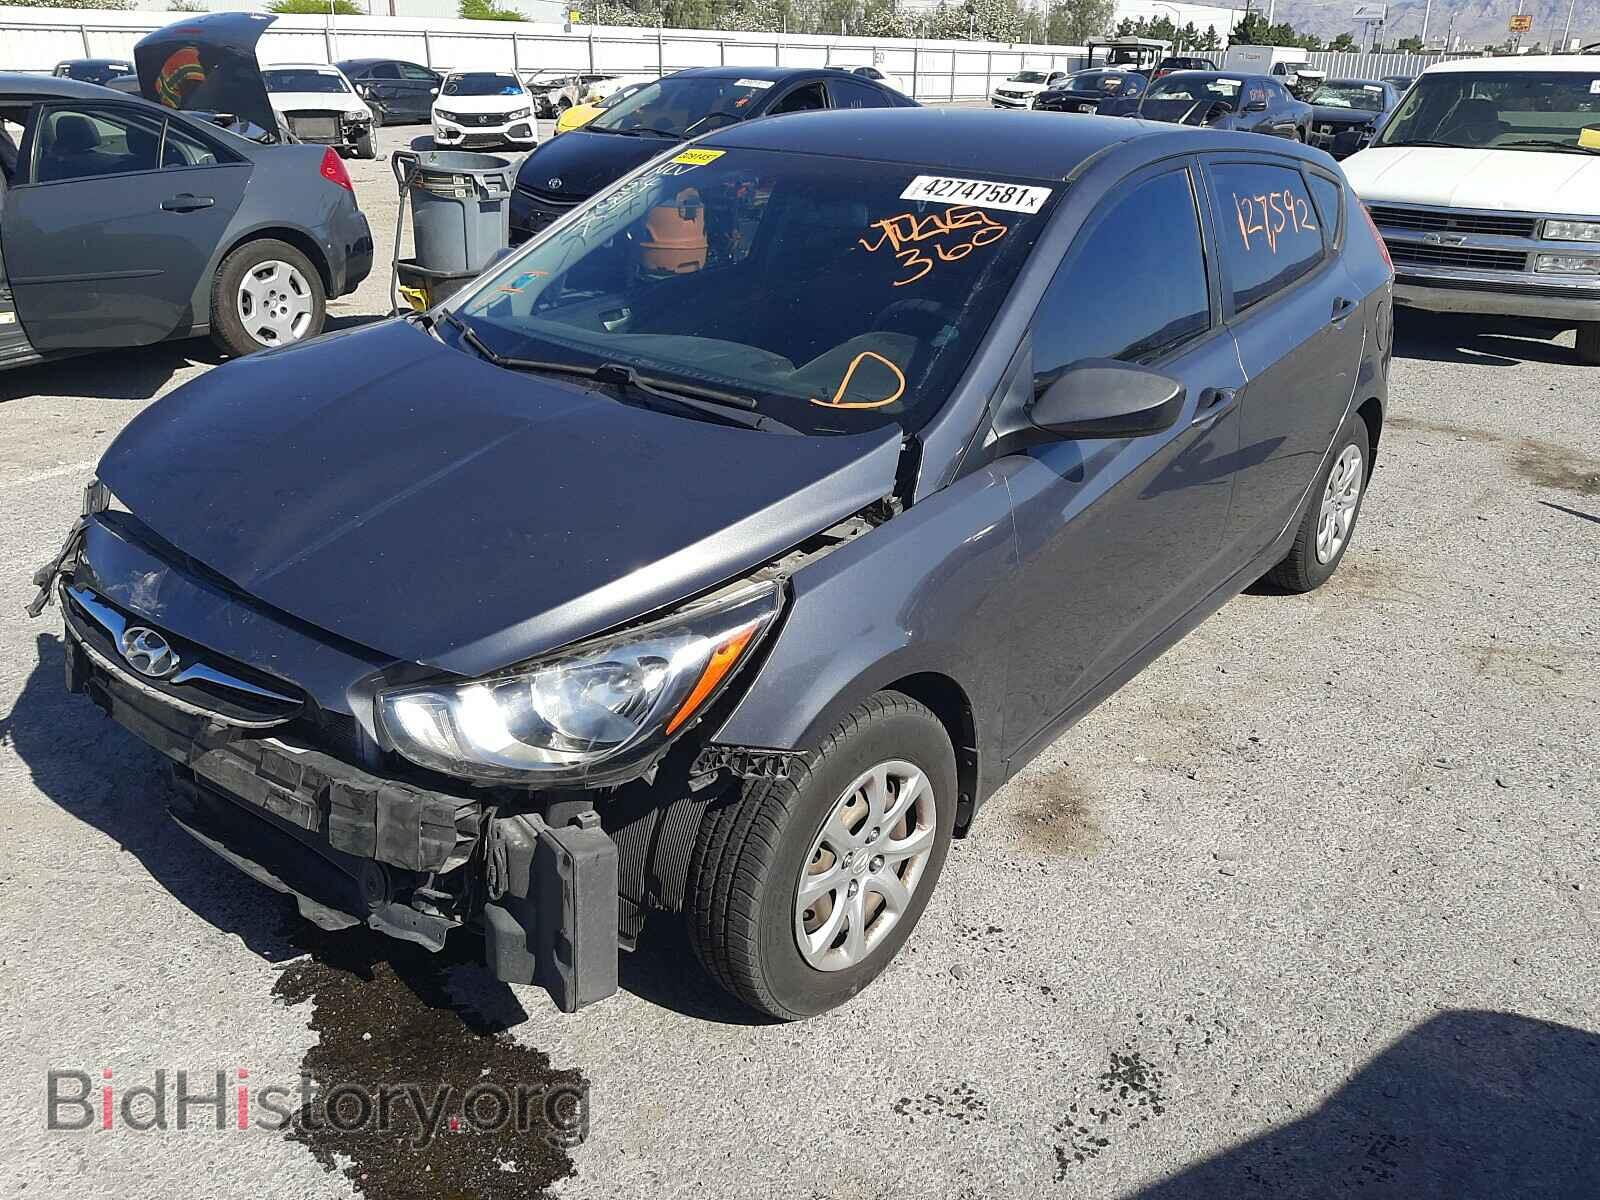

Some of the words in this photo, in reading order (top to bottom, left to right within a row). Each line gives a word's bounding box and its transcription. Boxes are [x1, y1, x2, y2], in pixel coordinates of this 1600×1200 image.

[924, 179, 1030, 205] 42747581
[1232, 190, 1316, 255] 127,592
[894, 226, 1008, 287] 360
